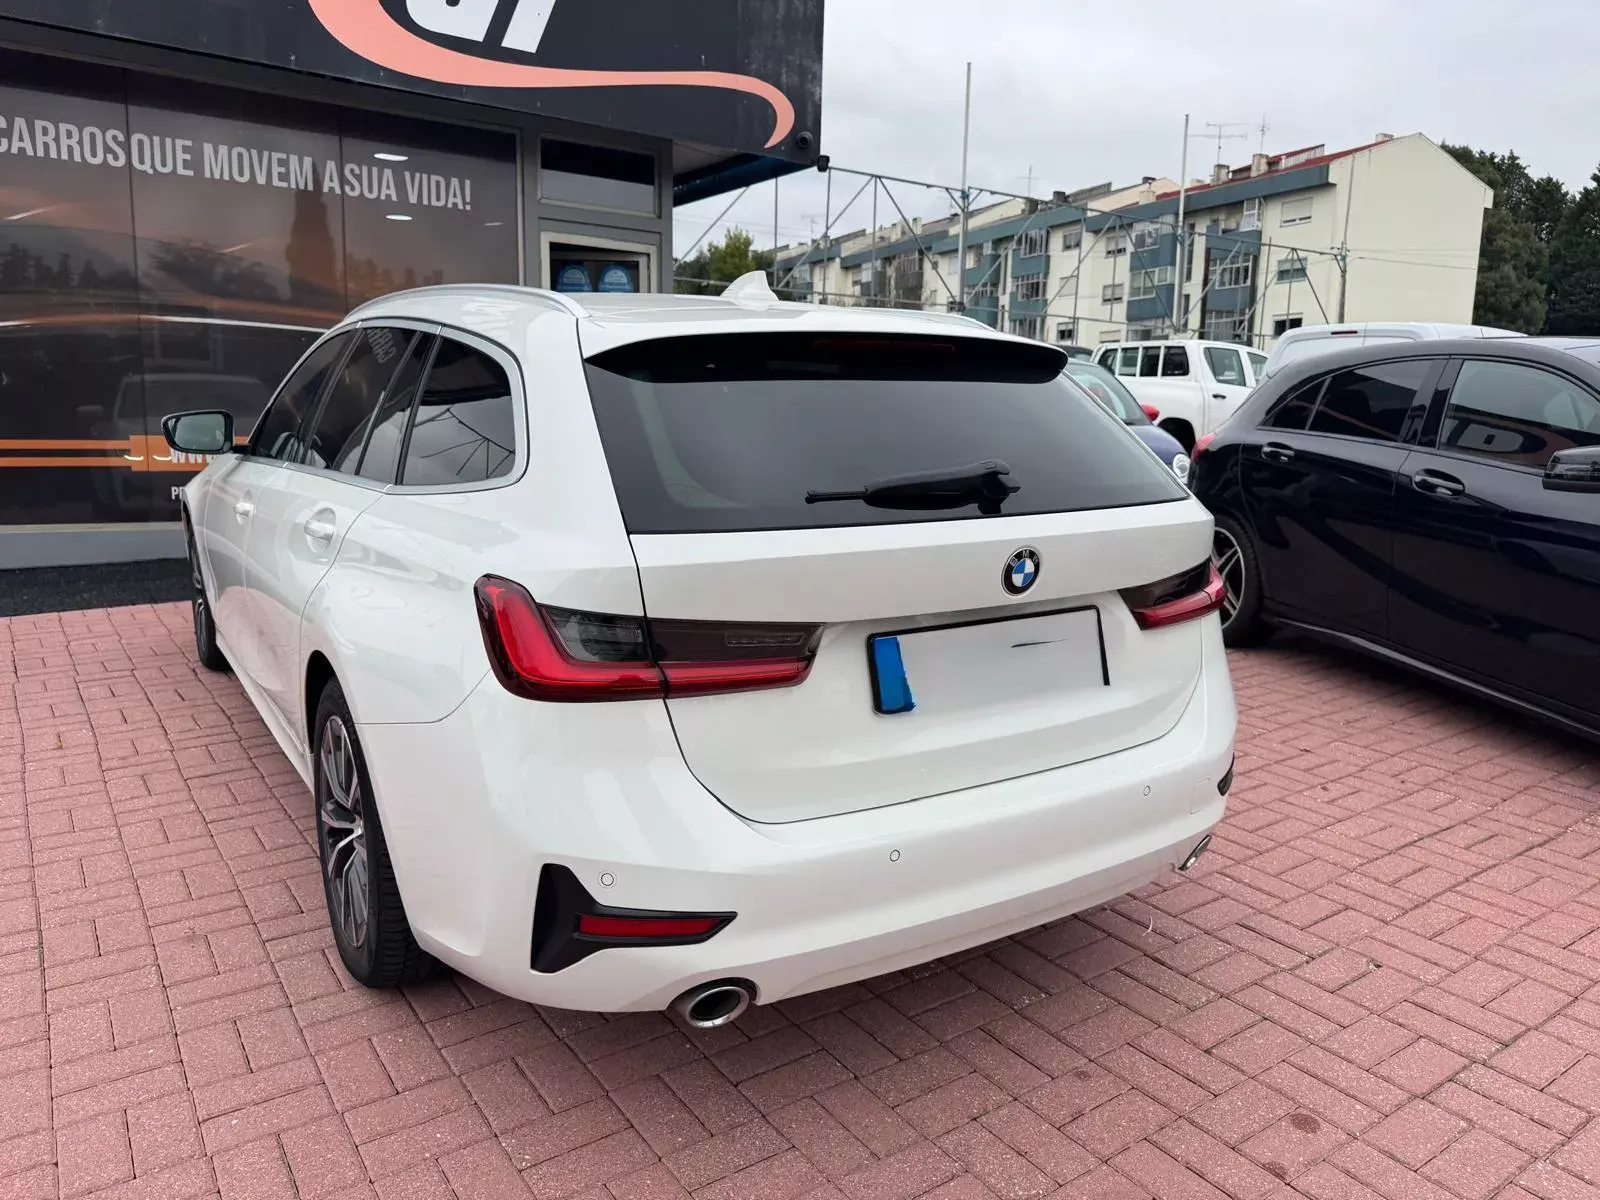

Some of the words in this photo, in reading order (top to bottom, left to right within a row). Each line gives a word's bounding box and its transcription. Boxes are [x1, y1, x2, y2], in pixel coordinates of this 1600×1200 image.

[130, 133, 194, 176] QUE
[203, 142, 314, 192] MOVEM
[322, 160, 342, 195] A
[343, 163, 398, 201] SUA
[404, 171, 472, 211] VIDA!
